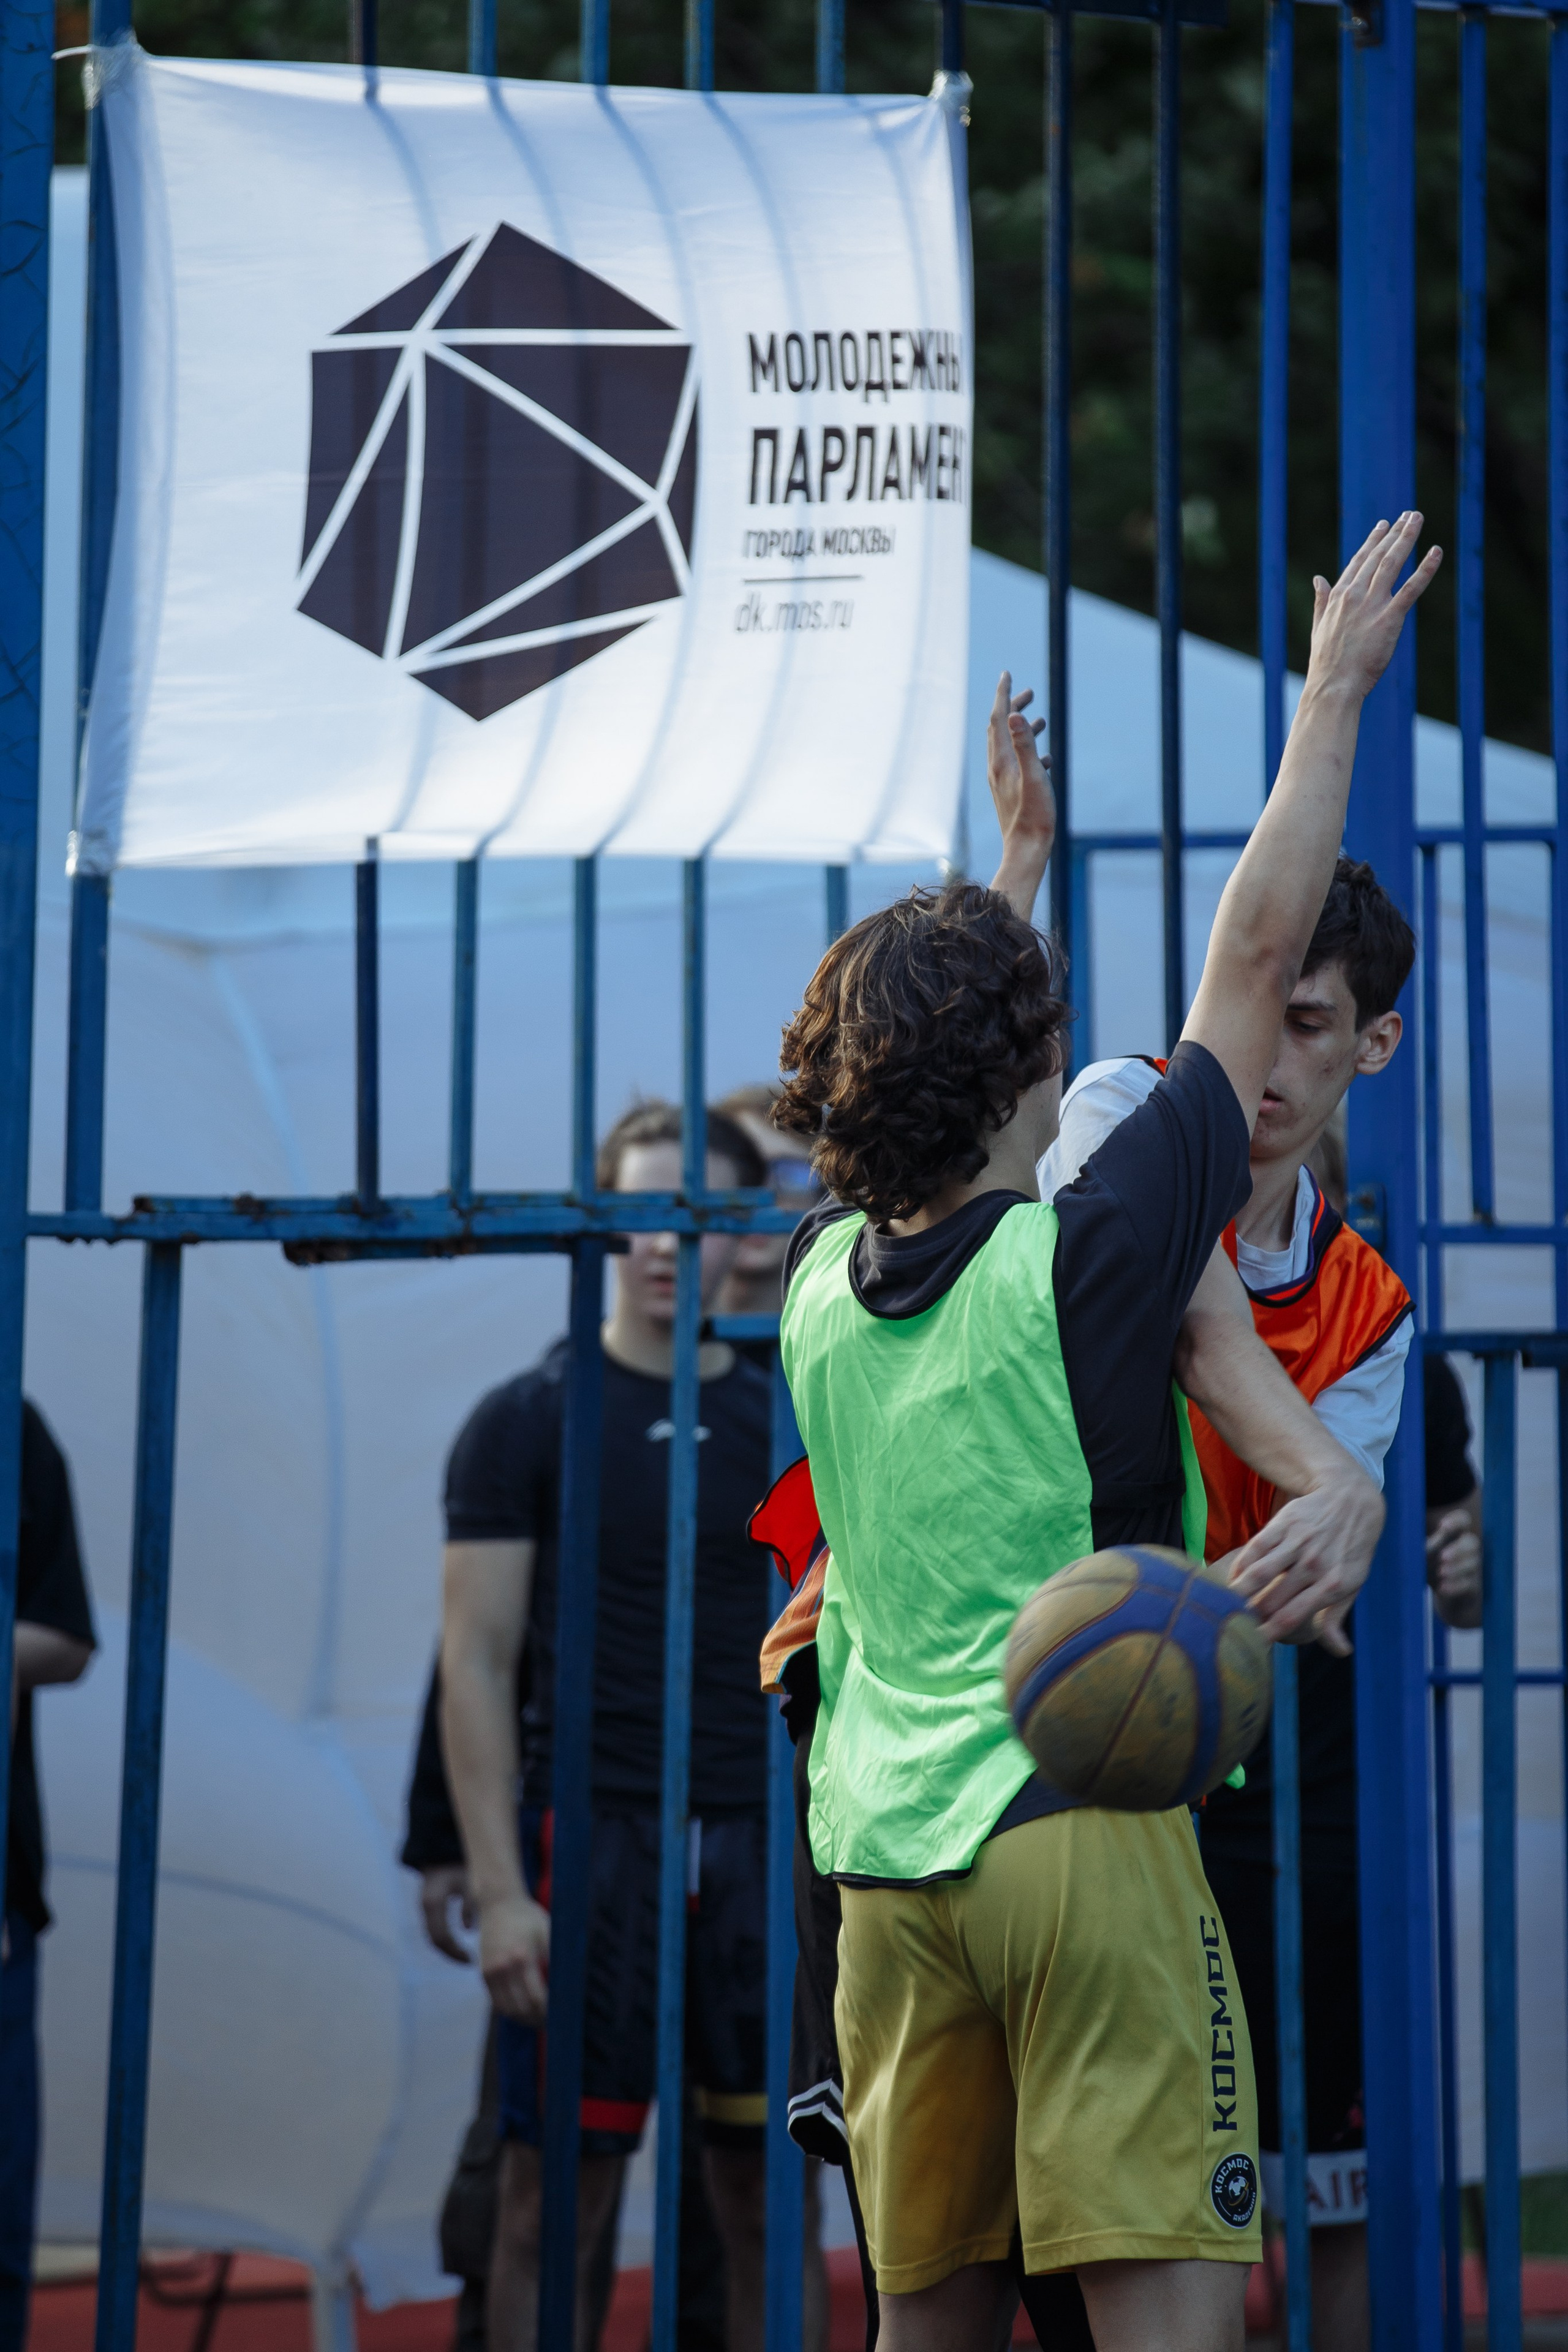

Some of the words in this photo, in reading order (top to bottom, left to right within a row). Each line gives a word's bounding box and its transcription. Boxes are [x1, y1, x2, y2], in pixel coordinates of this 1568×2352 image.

[748, 425, 966, 505] ПАРЛАМЕН
[745, 529, 815, 560] ГОРОДА
[823, 526, 895, 555] МОСКВЫ
[735, 592, 854, 631] dk.mos.ru
[1199, 1915, 1238, 2132] КОСМОС
[1215, 2158, 1250, 2193] КОСМОС
